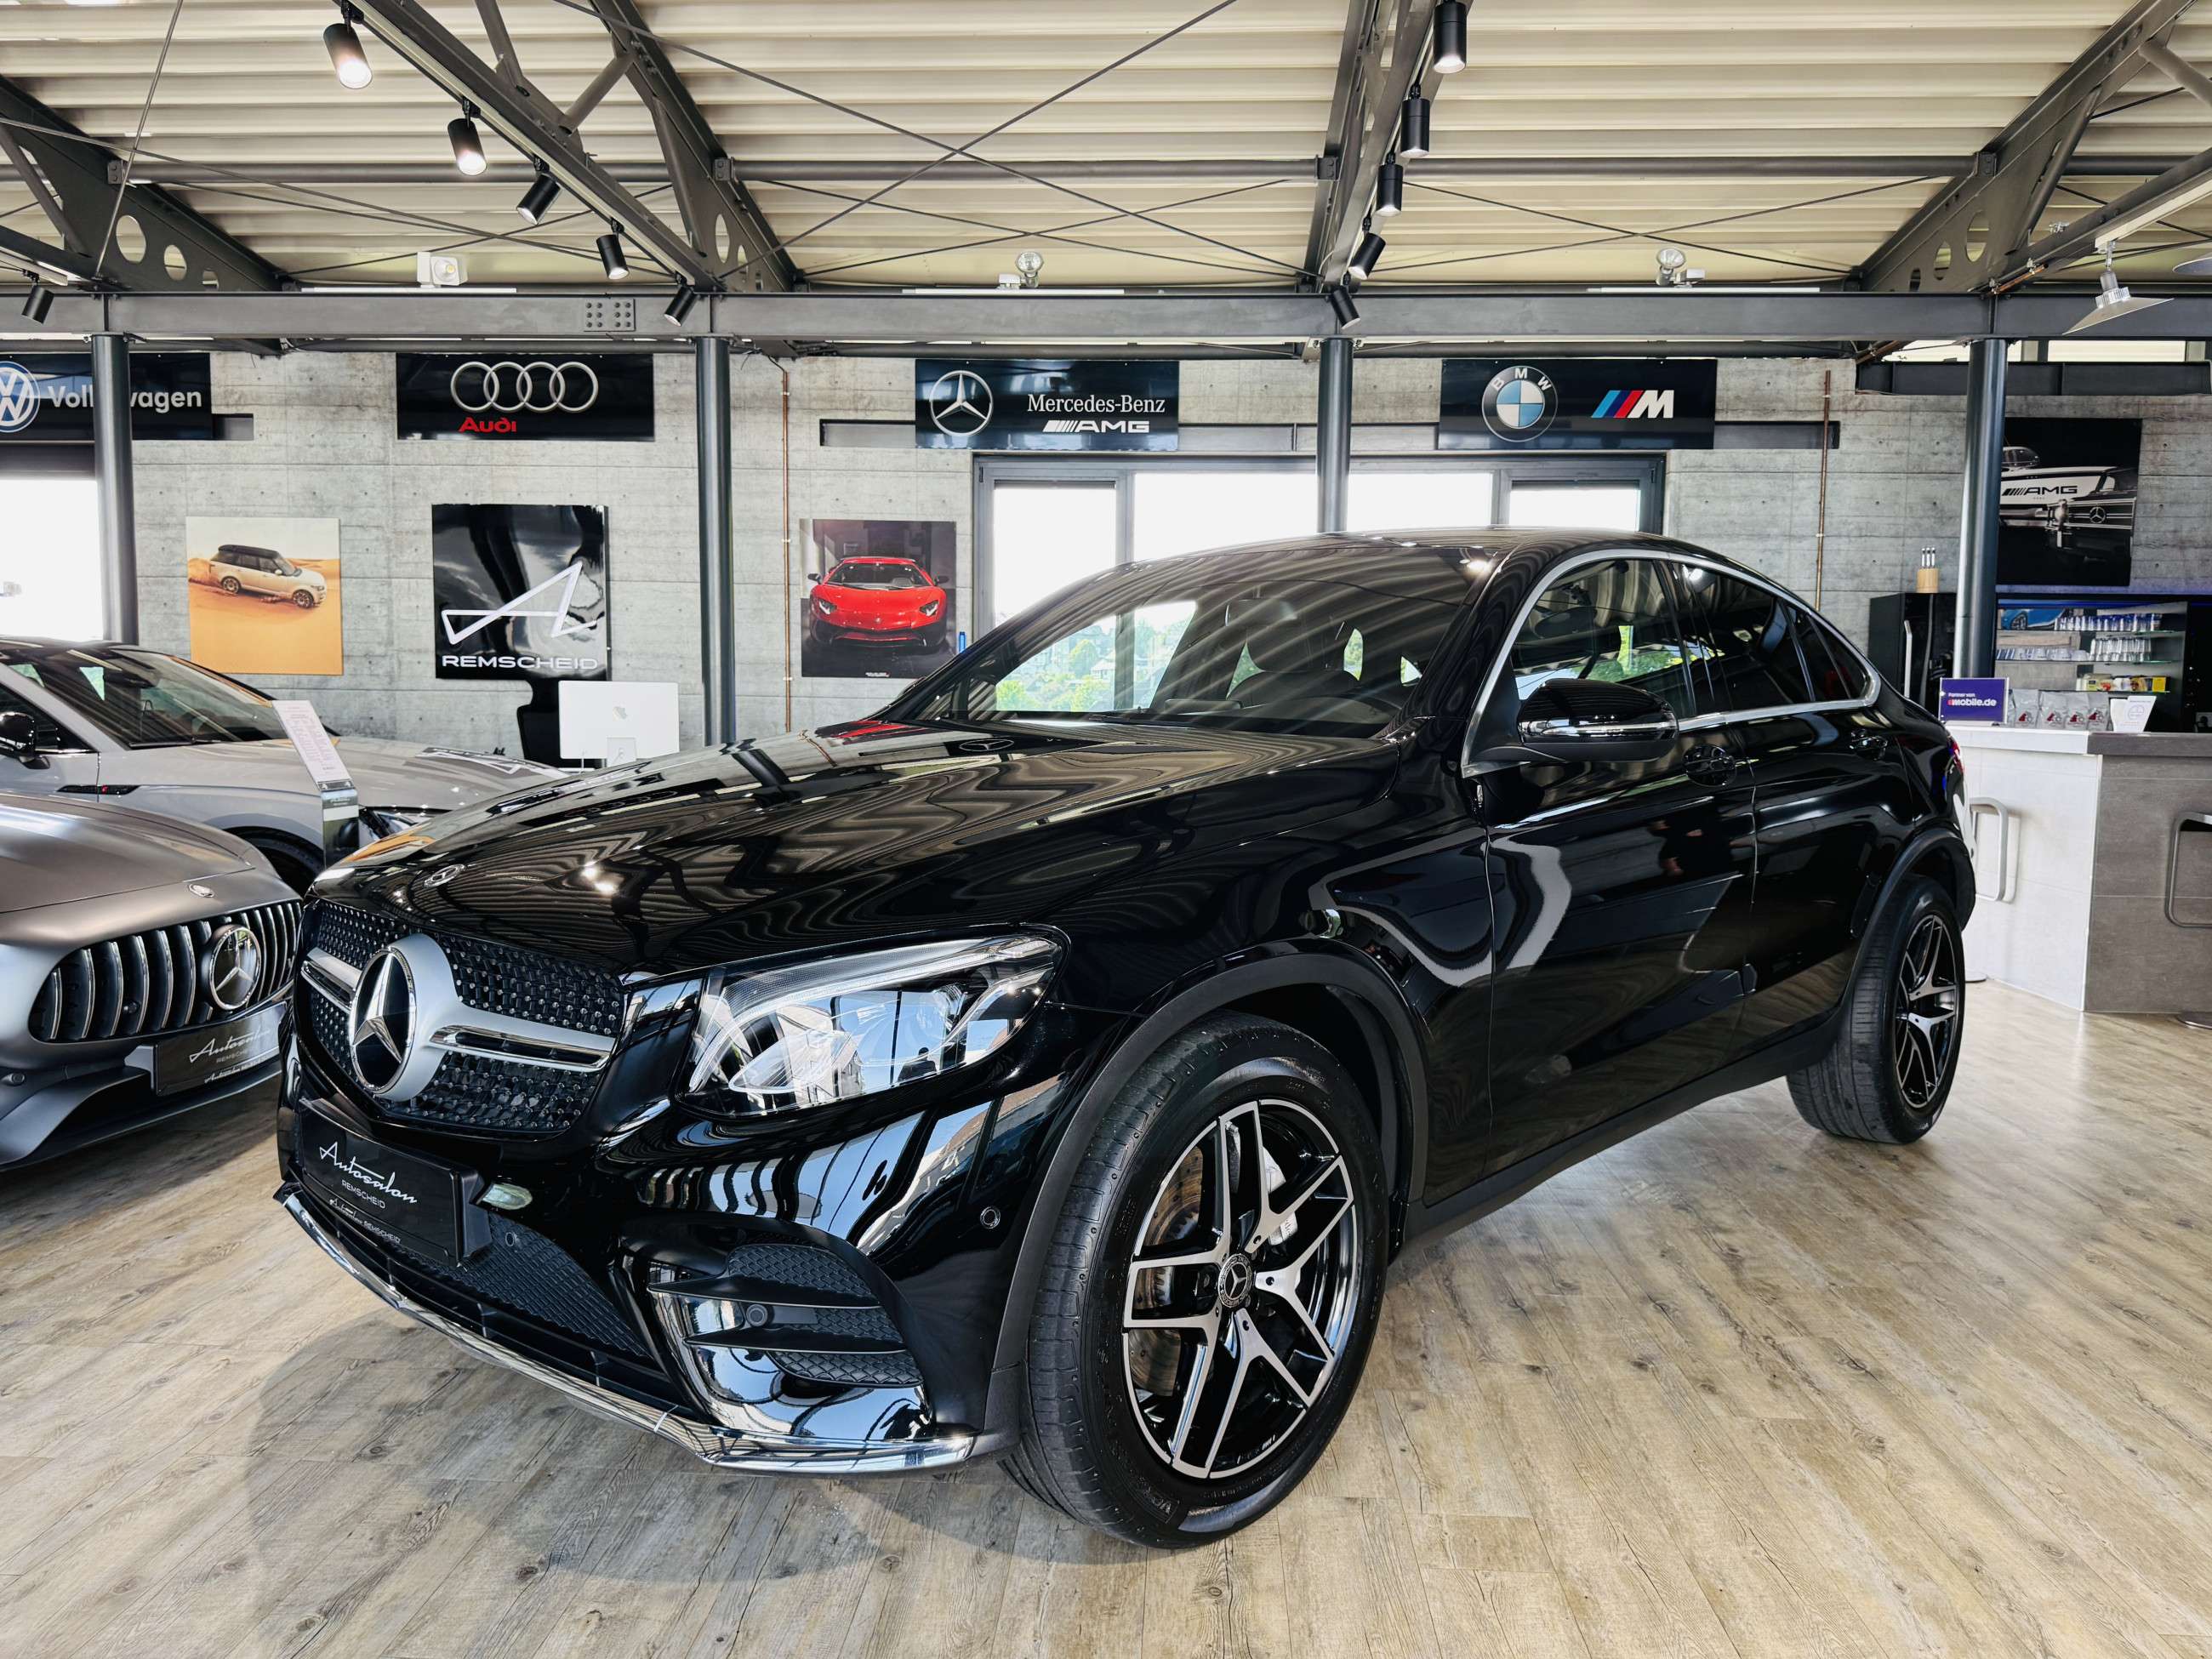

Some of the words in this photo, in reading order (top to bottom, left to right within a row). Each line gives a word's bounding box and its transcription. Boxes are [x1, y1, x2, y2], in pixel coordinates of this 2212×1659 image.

[47, 385, 202, 413] Volagen
[1027, 393, 1166, 413] Mercedes-Benz
[458, 417, 517, 433] Audi
[1074, 420, 1149, 433] AMG
[2024, 485, 2078, 495] AMG
[442, 654, 598, 670] REMSCHEID
[319, 1141, 417, 1204] Autosalon
[341, 1179, 385, 1209] REMSCHEID
